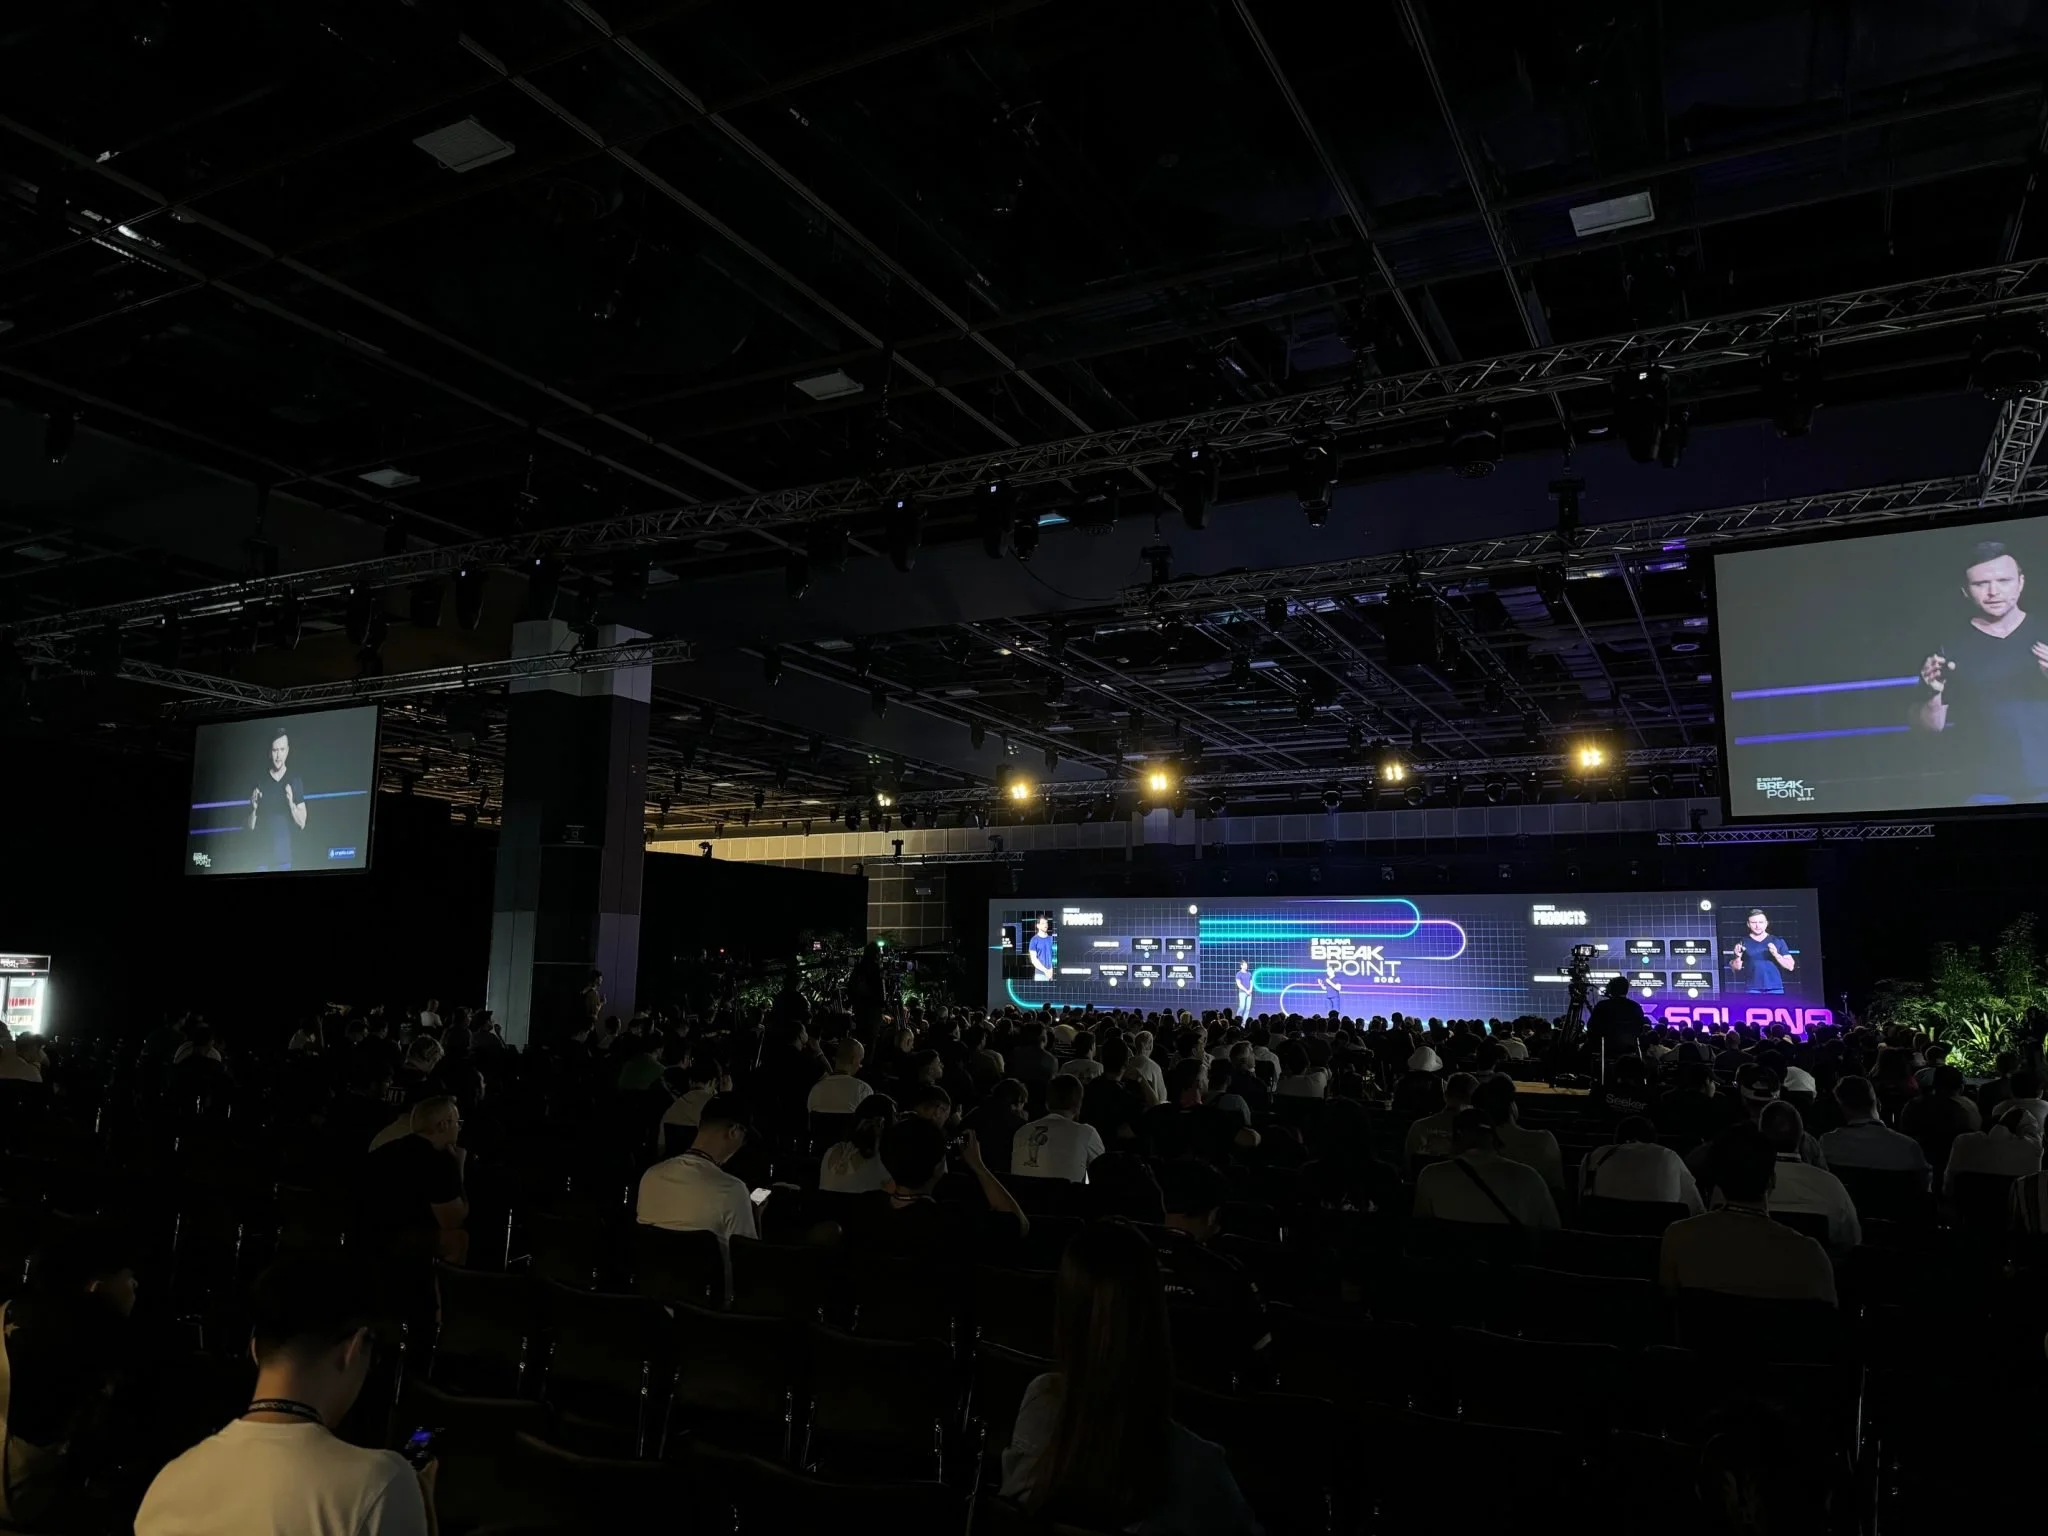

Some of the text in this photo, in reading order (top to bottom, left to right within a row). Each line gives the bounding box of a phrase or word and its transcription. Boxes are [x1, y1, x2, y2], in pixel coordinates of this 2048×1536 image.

[1756, 780, 1804, 790] BREAK
[1767, 788, 1815, 799] POINT
[1533, 911, 1587, 926] PRODUCTS
[1311, 945, 1385, 960] BREAK
[1327, 961, 1402, 976] POINT
[1605, 1093, 1648, 1110] Seeker
